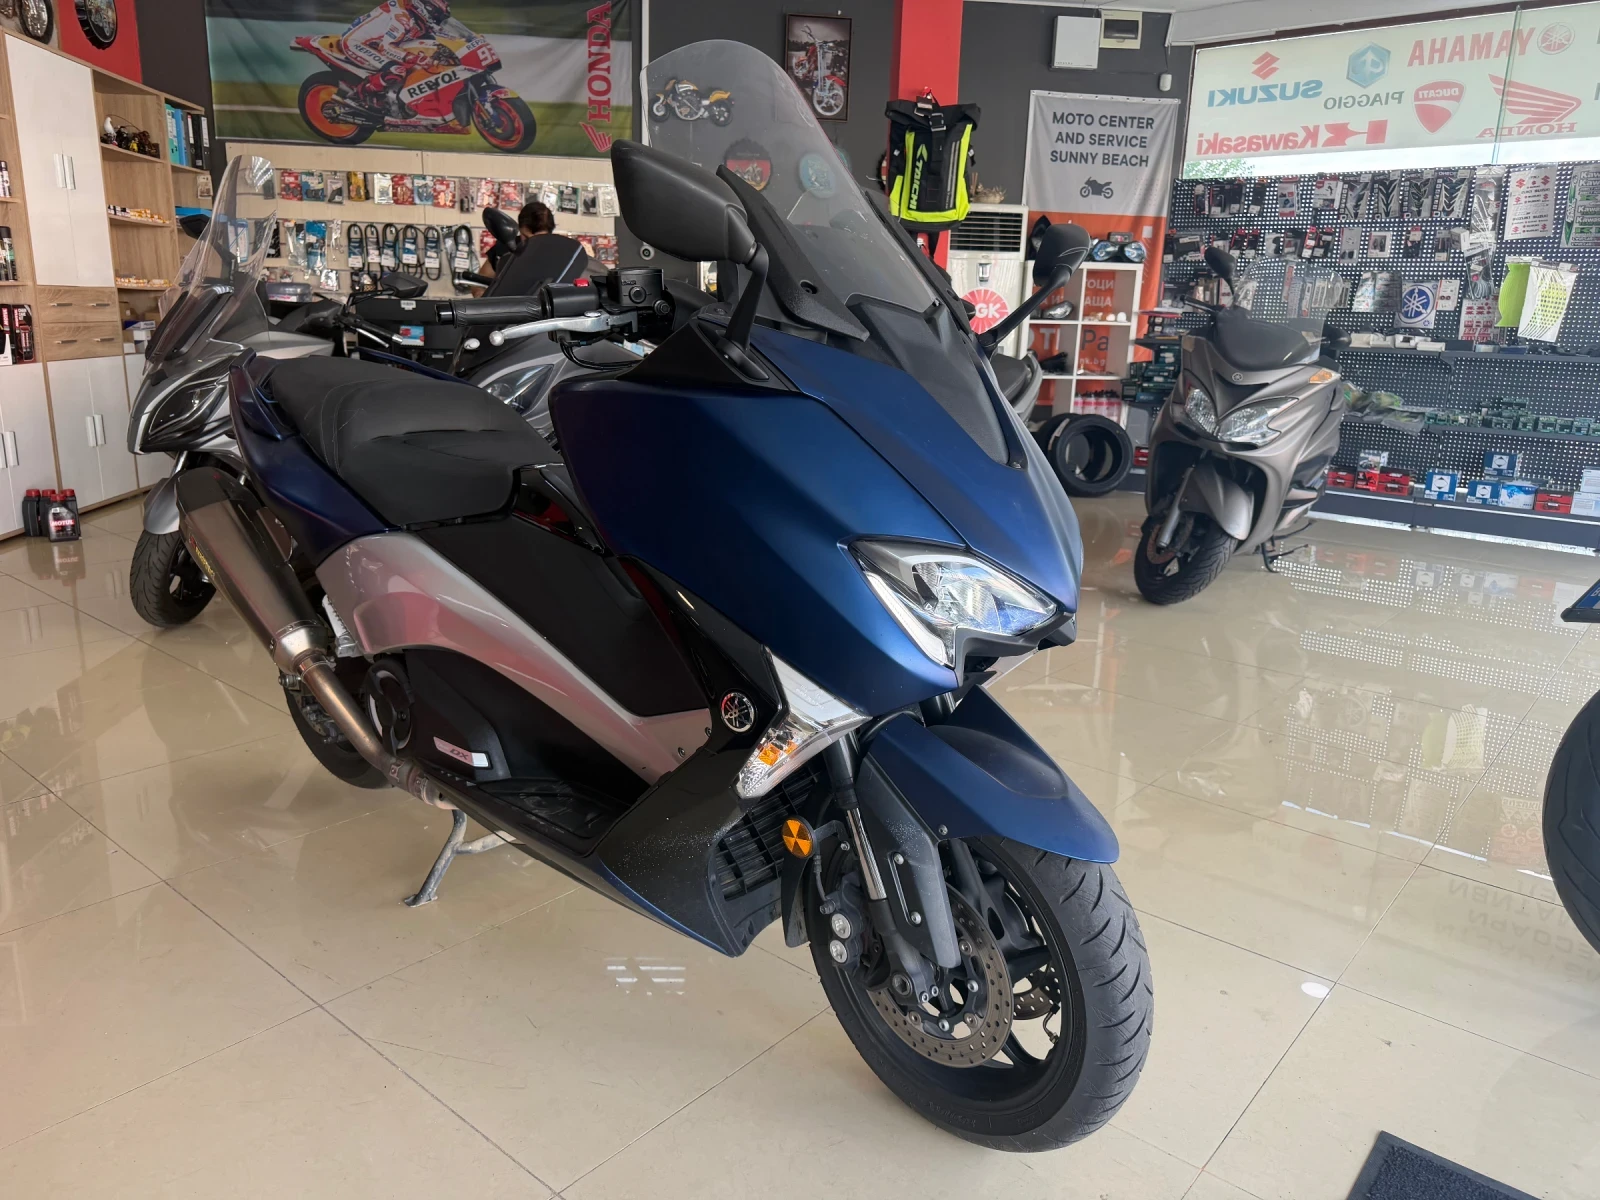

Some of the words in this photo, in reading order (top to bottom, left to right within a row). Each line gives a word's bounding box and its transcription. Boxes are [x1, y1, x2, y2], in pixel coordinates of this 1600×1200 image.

[587, 1, 612, 122] HONDA
[407, 69, 460, 99] REPSOL
[1052, 111, 1094, 126] MOTO
[1098, 114, 1155, 129] CENTER
[1055, 131, 1085, 145] AND
[1088, 133, 1148, 148] SERVICE
[1050, 149, 1098, 165] SUNNY
[1101, 153, 1149, 167] BEACH
[909, 159, 923, 210] TAICHI
[975, 302, 1001, 319] GK
[50, 519, 75, 527] MOTUL
[449, 748, 469, 760] DX
